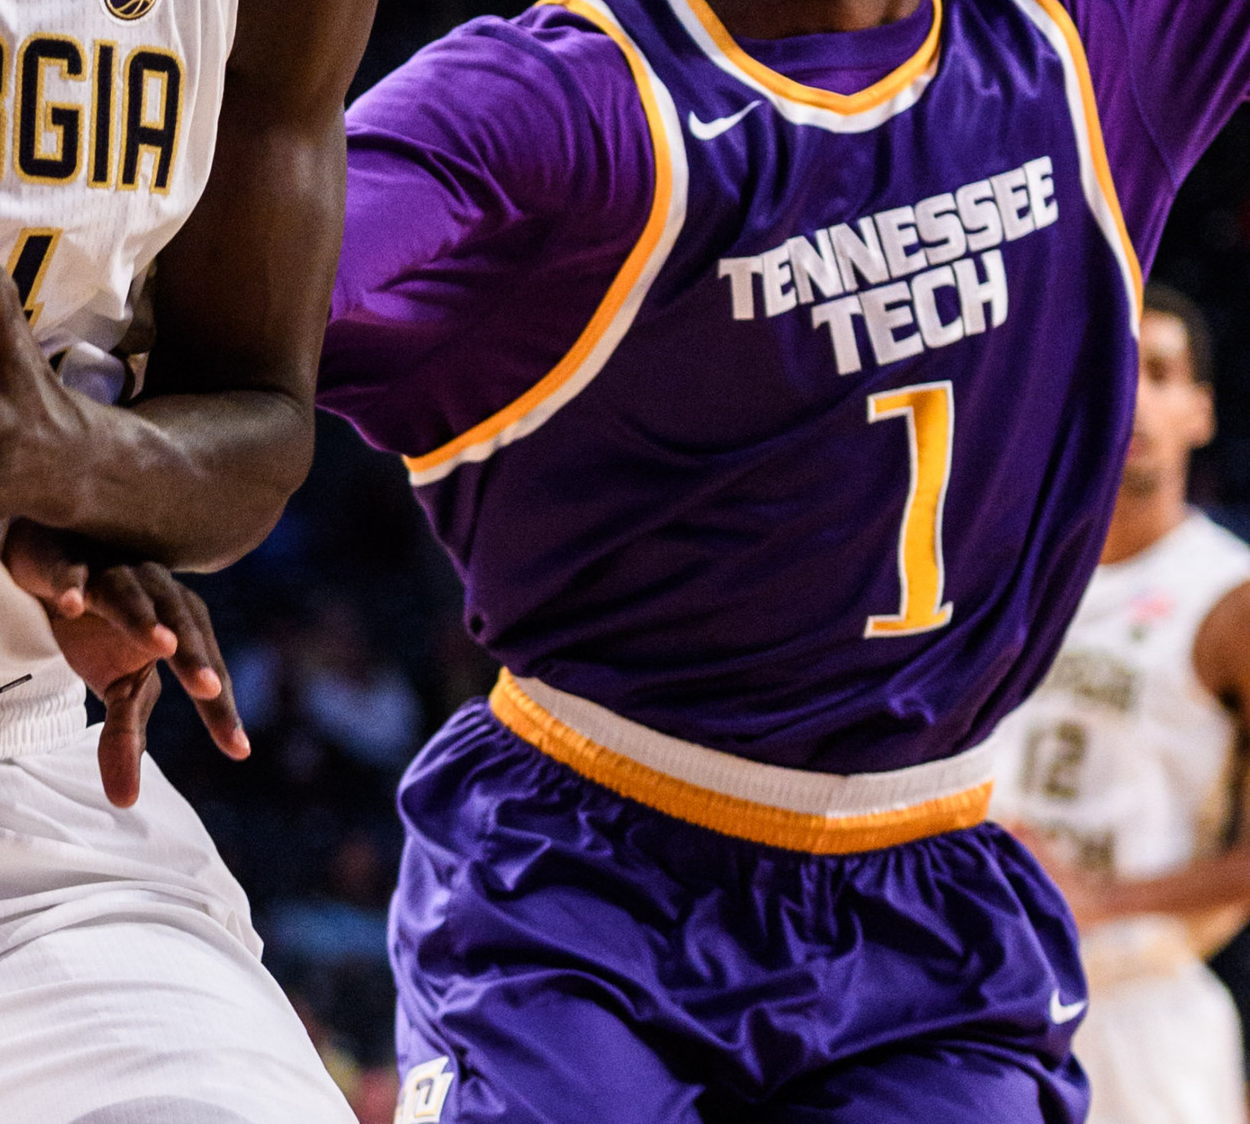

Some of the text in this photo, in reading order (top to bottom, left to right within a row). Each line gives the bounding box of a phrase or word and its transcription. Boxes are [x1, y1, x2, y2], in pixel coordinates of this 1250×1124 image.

[717, 155, 1059, 321] TENNESSEE
[812, 248, 1009, 375] TECH
[863, 380, 955, 639] 1
